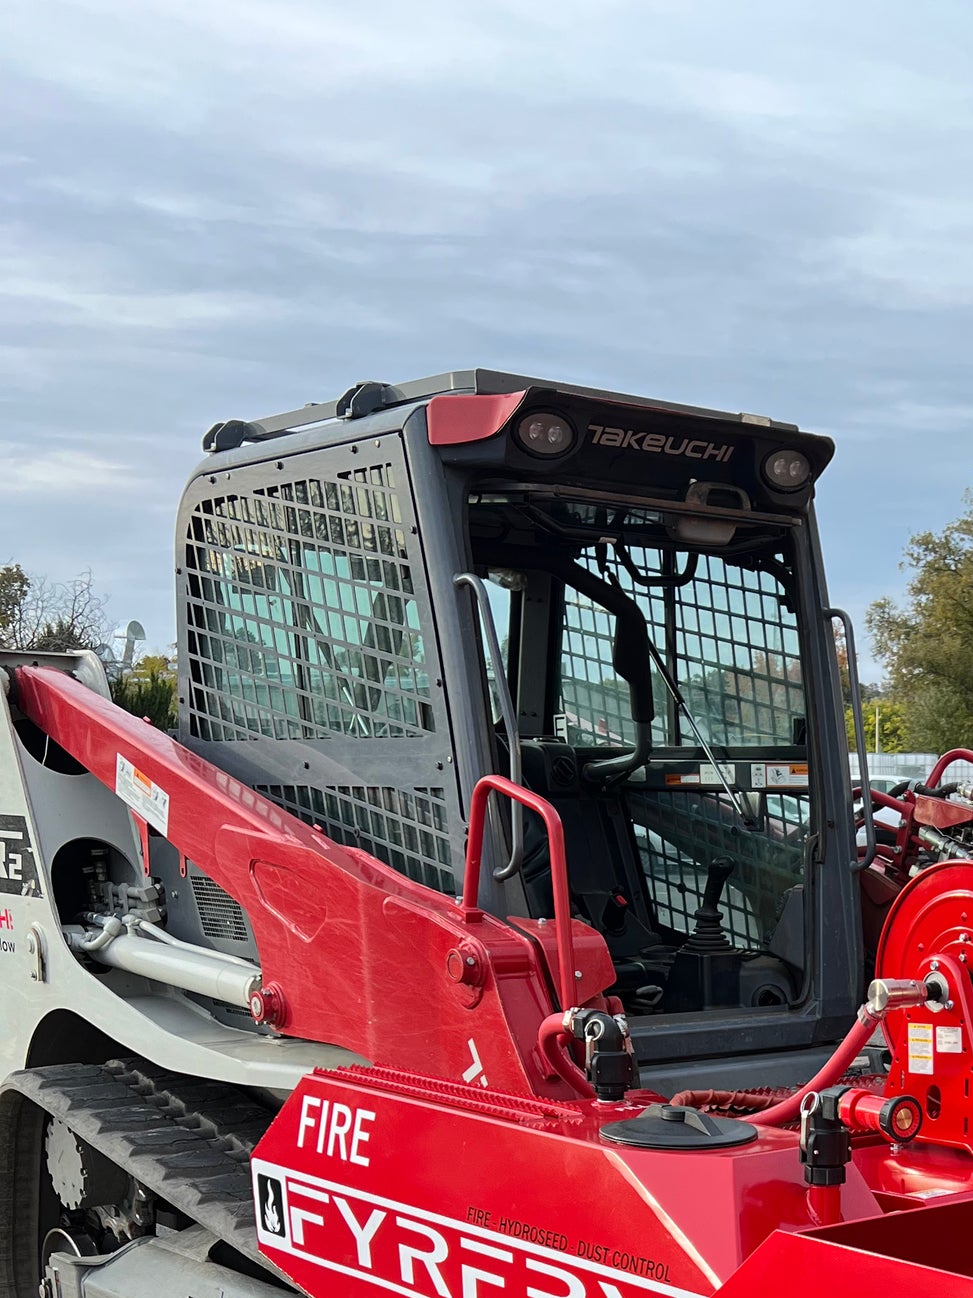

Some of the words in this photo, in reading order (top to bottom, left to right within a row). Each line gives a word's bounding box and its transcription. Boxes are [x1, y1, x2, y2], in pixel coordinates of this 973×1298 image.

[588, 424, 735, 462] TAKEUCHI
[297, 1095, 376, 1167] FIRE
[467, 1206, 491, 1227] FIRE
[499, 1217, 568, 1251] HYDROSEED
[577, 1240, 610, 1262] DUST
[612, 1251, 671, 1282] CONTROL
